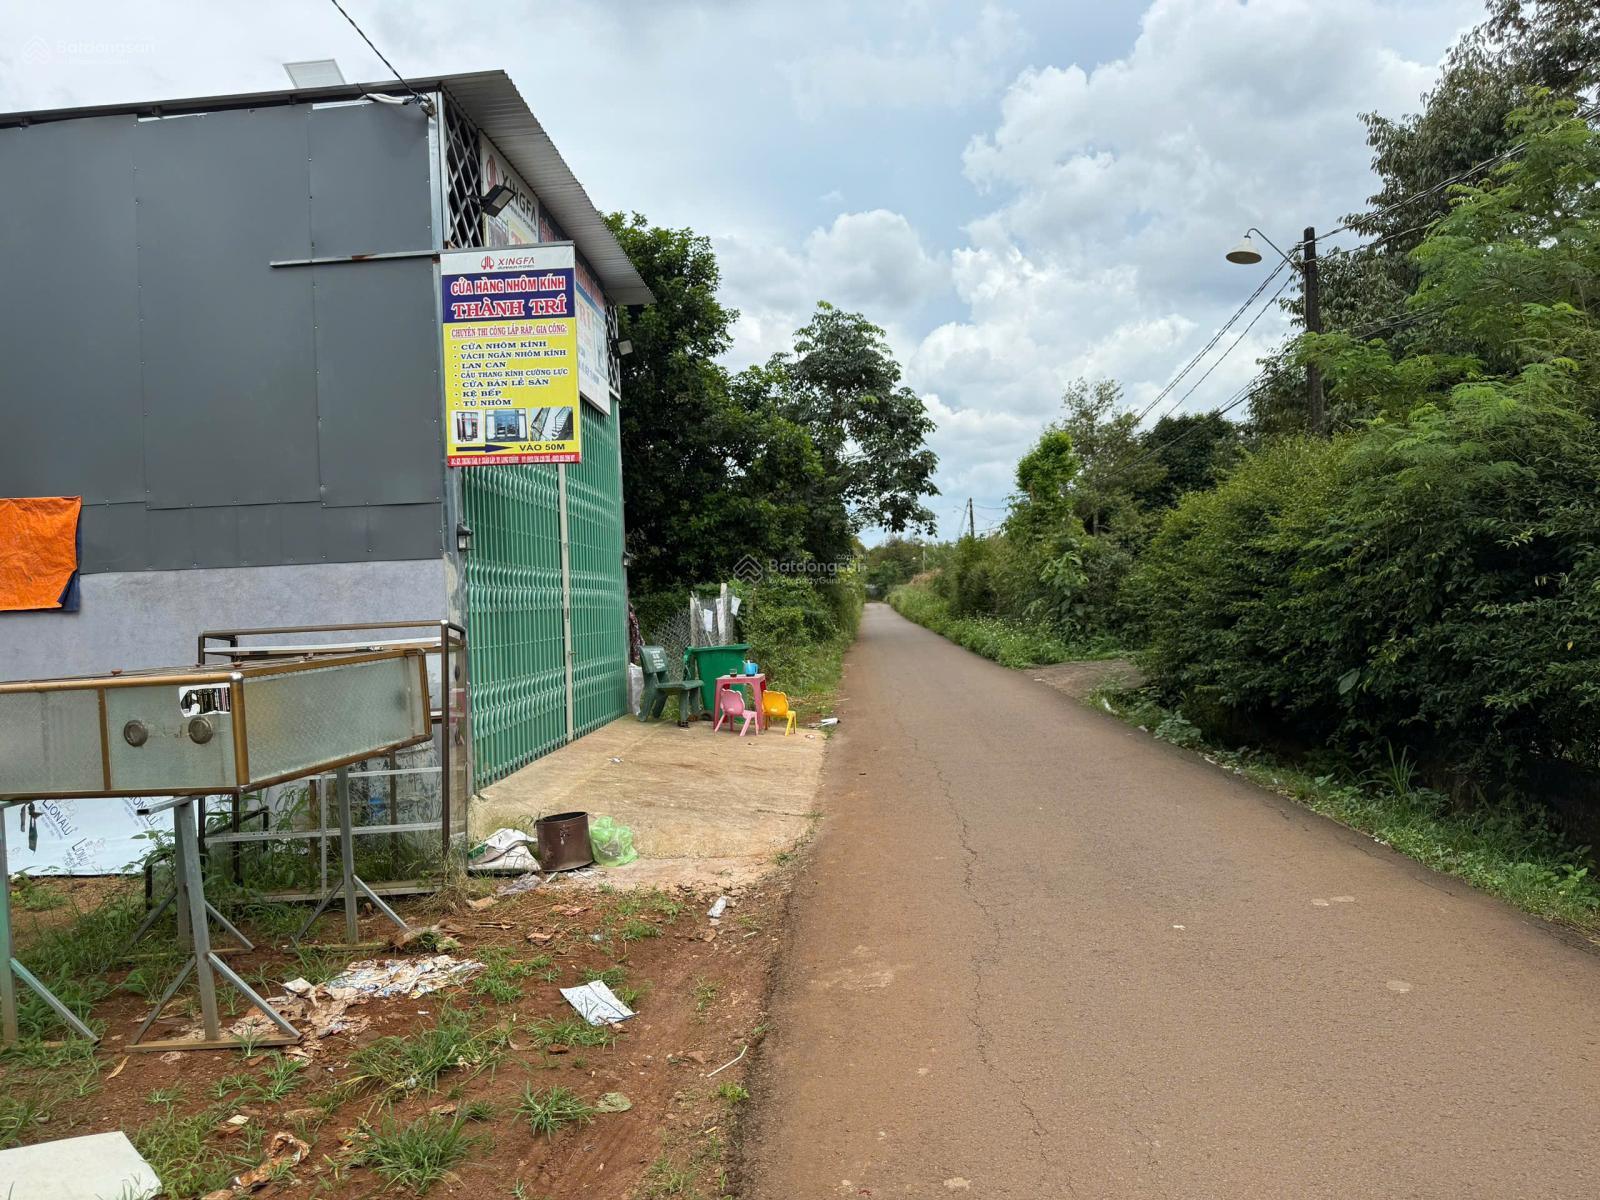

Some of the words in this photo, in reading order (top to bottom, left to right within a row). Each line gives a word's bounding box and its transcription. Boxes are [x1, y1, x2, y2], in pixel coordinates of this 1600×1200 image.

[498, 256, 535, 266] XINGFA
[451, 276, 473, 296] CỬA
[475, 276, 504, 294] HÀNG
[505, 275, 537, 293] NHÔM
[539, 273, 566, 291] KÍNH
[451, 297, 525, 319] THÀNH
[529, 293, 567, 315] TRÍ
[477, 328, 488, 336] THI
[489, 326, 507, 336] CÔNG
[536, 325, 547, 334] GIA
[486, 341, 516, 349] NHÔM
[460, 352, 485, 360] VÁCH
[477, 370, 503, 378] THANG
[505, 369, 523, 377] KÍNH
[462, 390, 477, 398] KỆ
[481, 388, 502, 397] BẾP
[520, 443, 542, 452] VÀO
[545, 443, 565, 451] 50M
